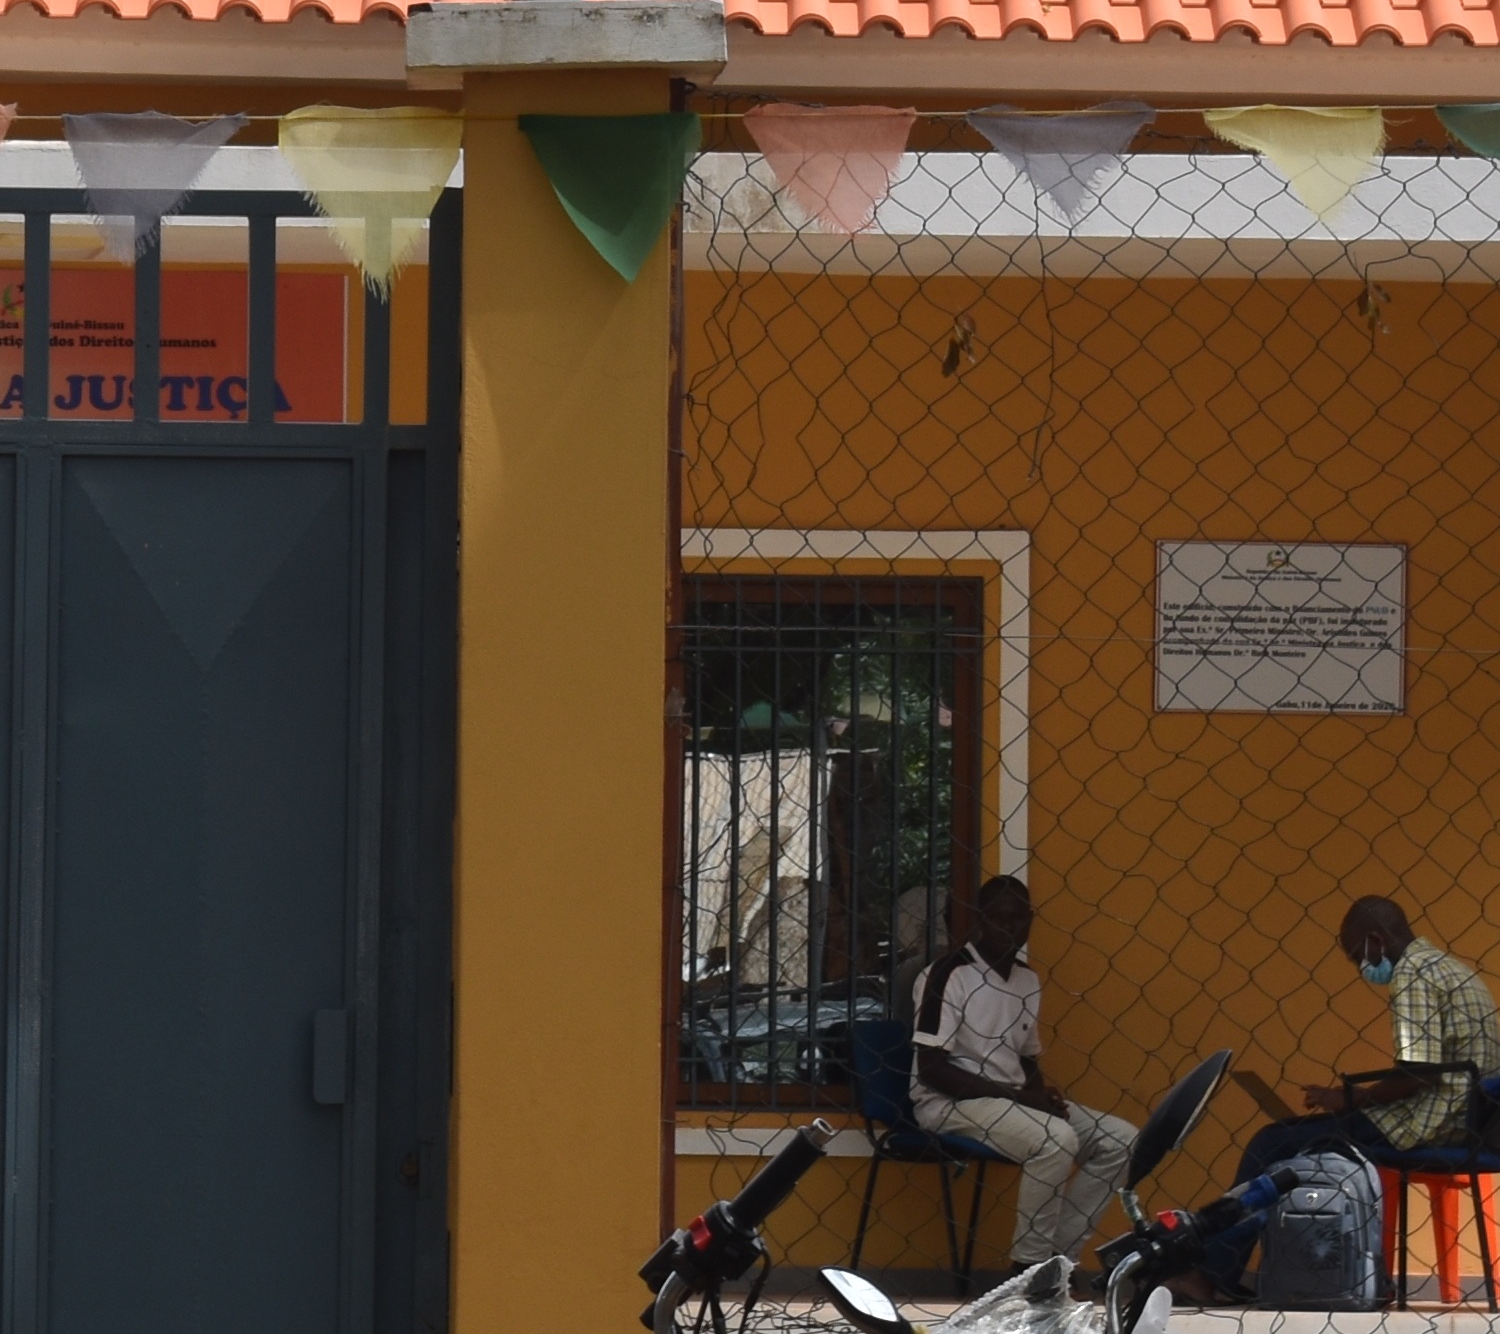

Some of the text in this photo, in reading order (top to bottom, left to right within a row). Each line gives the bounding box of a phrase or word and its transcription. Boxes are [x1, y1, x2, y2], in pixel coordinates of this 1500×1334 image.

[50, 319, 125, 331] uiné-Bissau
[49, 335, 75, 348] dos
[78, 335, 135, 349] Direito
[158, 336, 217, 349] umanos
